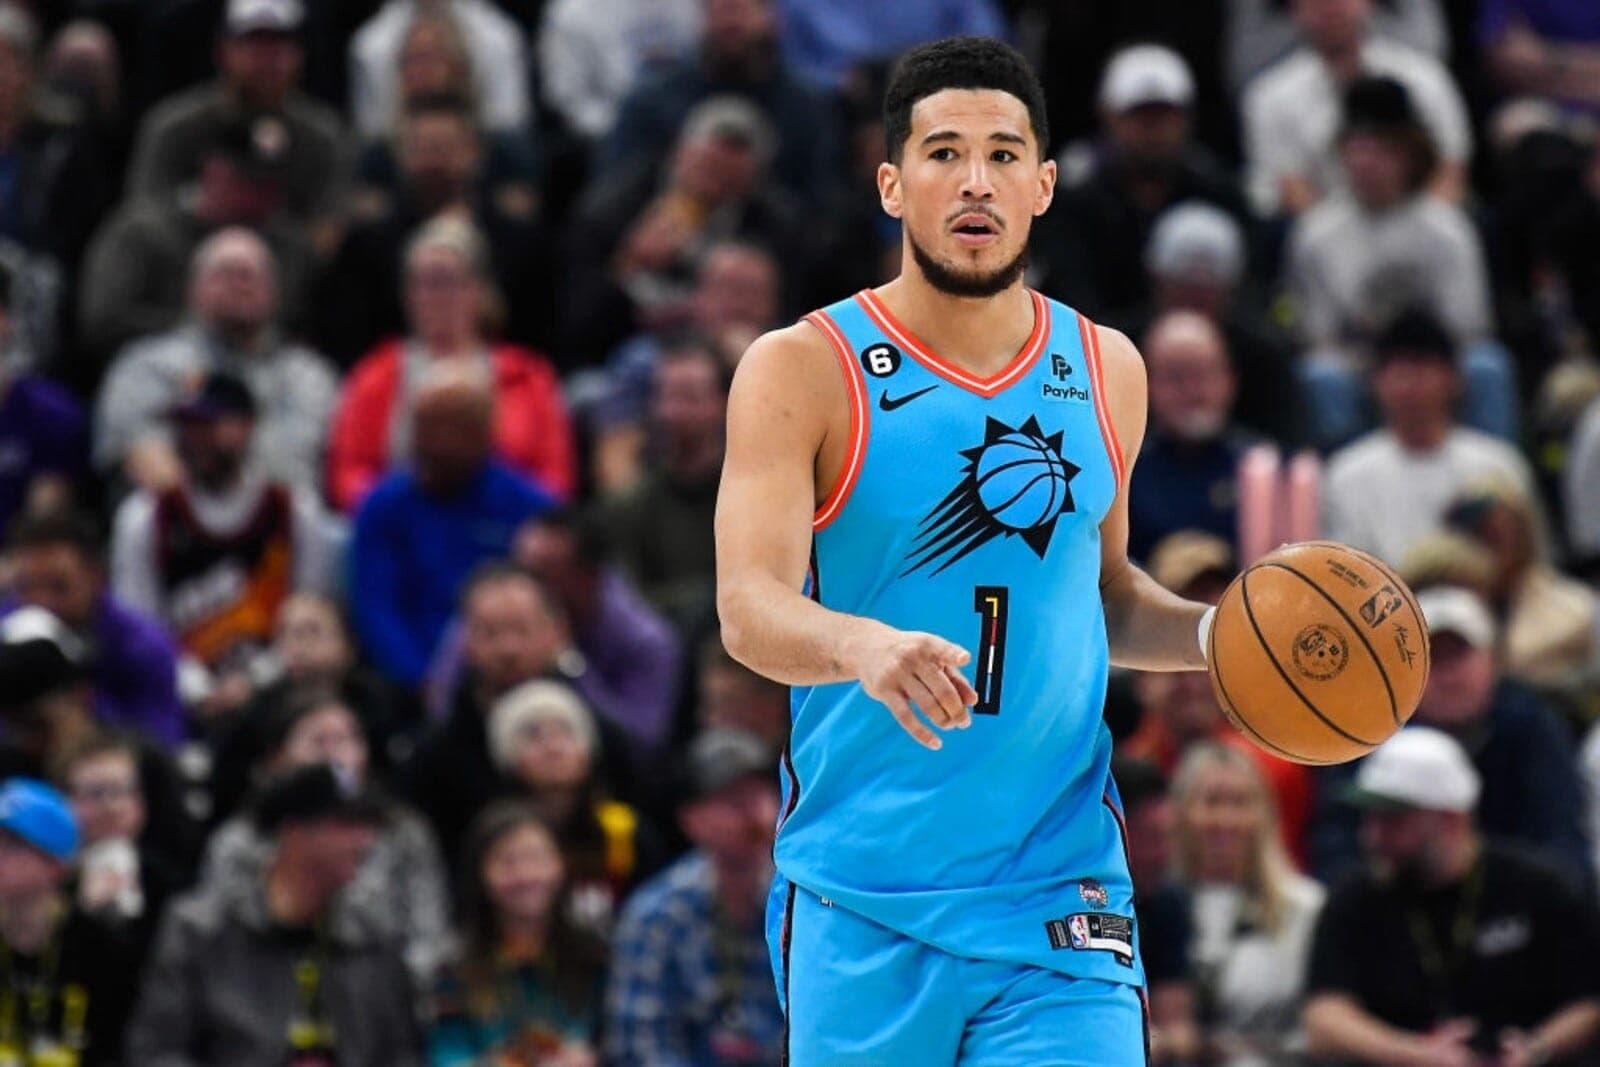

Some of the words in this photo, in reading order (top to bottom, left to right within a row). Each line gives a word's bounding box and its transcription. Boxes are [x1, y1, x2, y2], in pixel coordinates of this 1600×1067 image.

[869, 347, 893, 375] 6
[1043, 384, 1089, 401] PayPal
[973, 585, 1009, 715] 1
